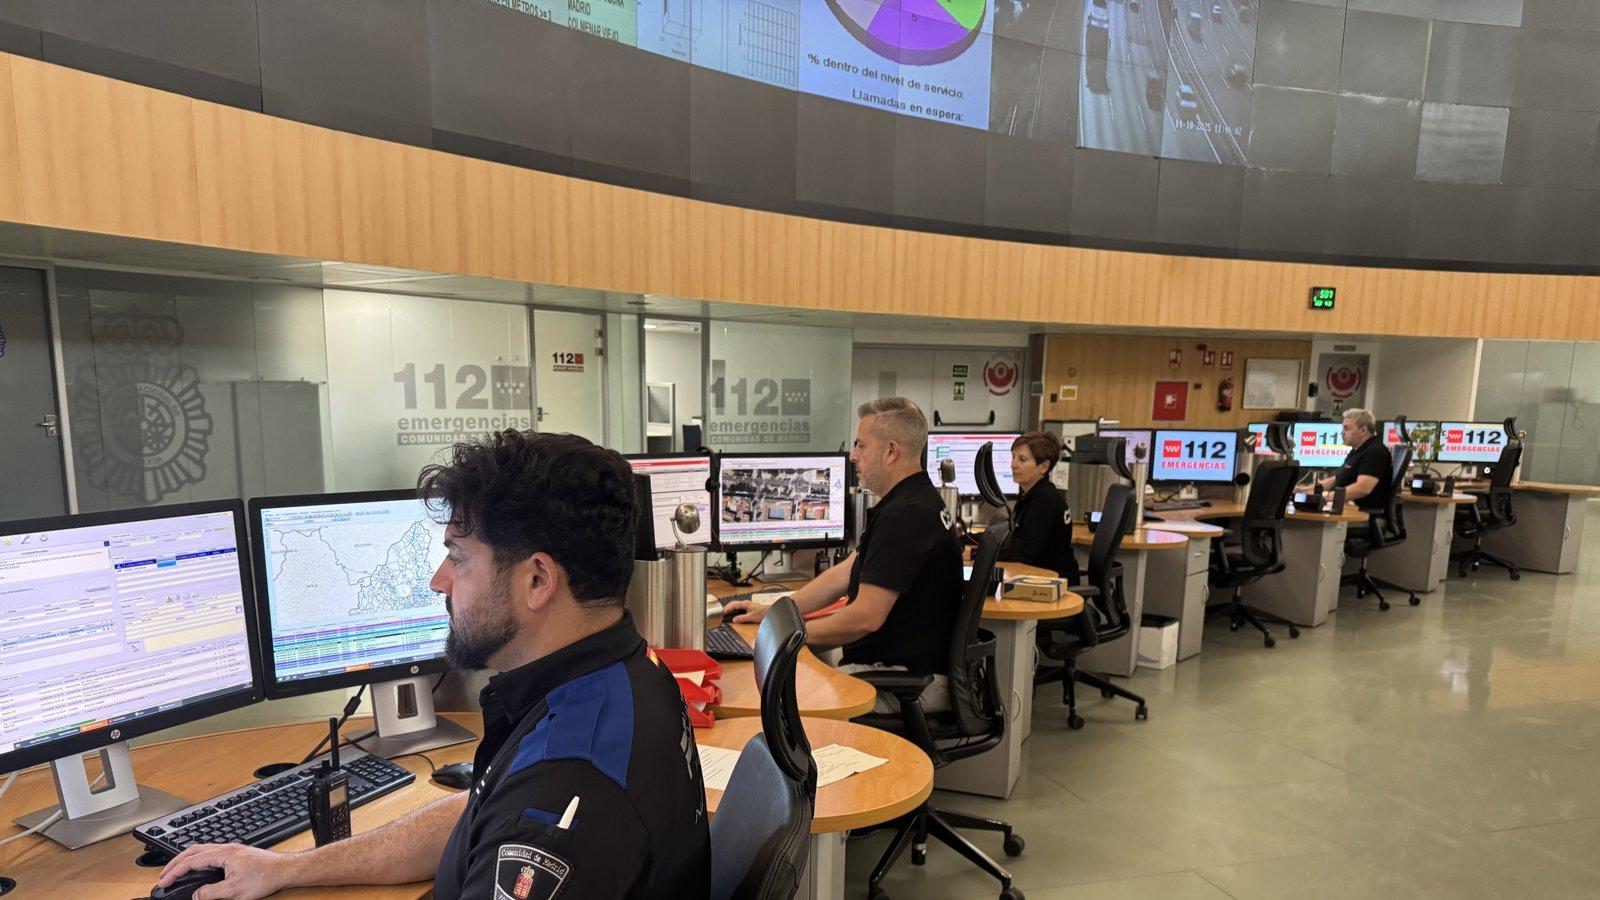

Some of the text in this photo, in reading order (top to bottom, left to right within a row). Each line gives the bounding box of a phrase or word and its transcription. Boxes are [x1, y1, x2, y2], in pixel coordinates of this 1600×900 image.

[567, 0, 591, 15] MADRID
[567, 16, 601, 36] COLMENAR
[808, 53, 966, 99] % dentro del nivel de servicio:
[852, 88, 964, 122] Llamadas en espera:
[552, 352, 574, 364] 112
[393, 362, 489, 410] 112
[710, 376, 779, 416] 112
[397, 413, 530, 433] emergencias
[709, 418, 811, 435] emergencias
[400, 434, 467, 444] COMUNIDAD
[1319, 432, 1344, 445] 11
[1465, 430, 1501, 444] 112
[1185, 440, 1227, 459] 112
[1161, 461, 1227, 470] EMERGENCIAS
[501, 848, 566, 874] Comunidad de Madrid
